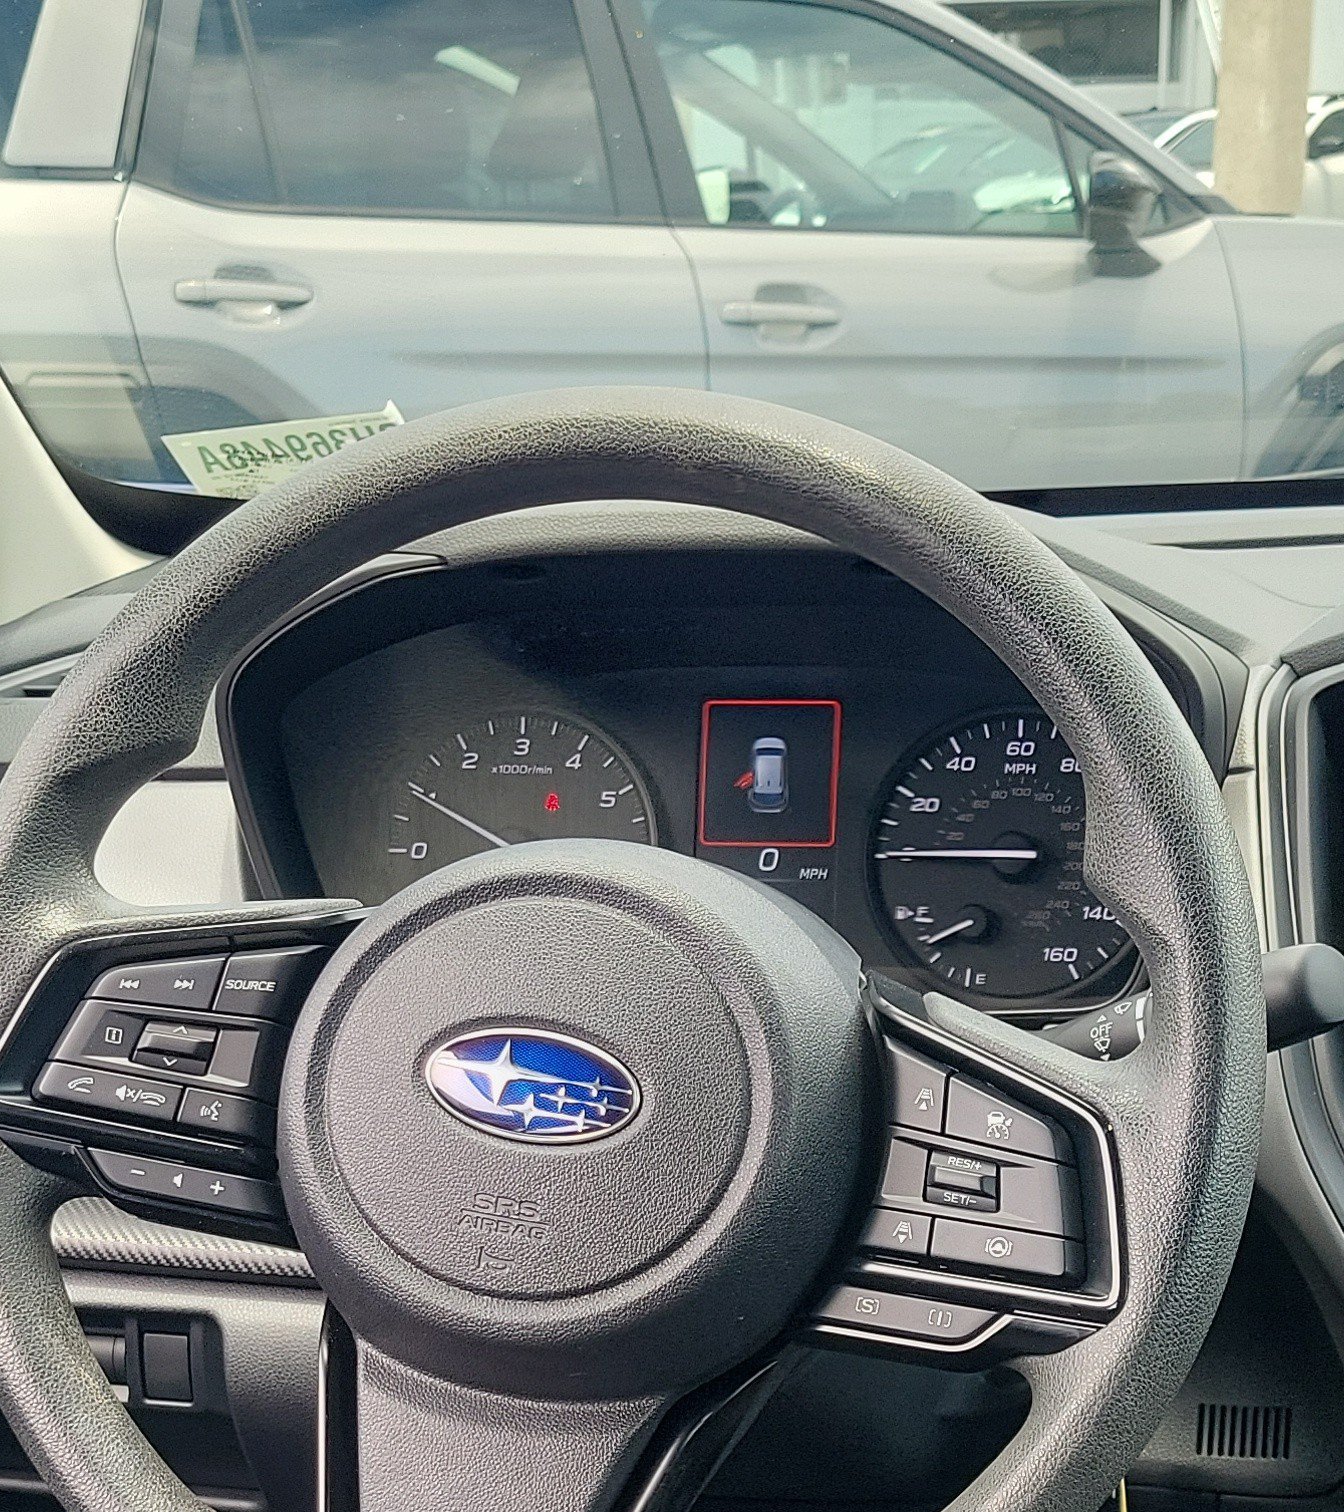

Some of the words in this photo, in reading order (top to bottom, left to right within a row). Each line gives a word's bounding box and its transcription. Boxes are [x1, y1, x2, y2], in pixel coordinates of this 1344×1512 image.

[514, 737, 531, 756] 3
[1006, 741, 1036, 757] 60
[461, 753, 479, 770] 2
[564, 754, 583, 770] 4
[946, 756, 976, 772] 40
[1004, 763, 1036, 775] MPH
[599, 790, 617, 808] 5
[909, 797, 940, 813] 20
[411, 842, 428, 860] 0
[758, 848, 779, 872] 0
[799, 868, 829, 880] MPH
[917, 906, 928, 918] F
[1043, 948, 1078, 962] 160
[224, 979, 276, 992] SOURCE
[976, 973, 987, 984] E
[1089, 1022, 1112, 1038] OFF
[472, 1192, 541, 1222] SRS
[457, 1213, 548, 1241] AIRBAG
